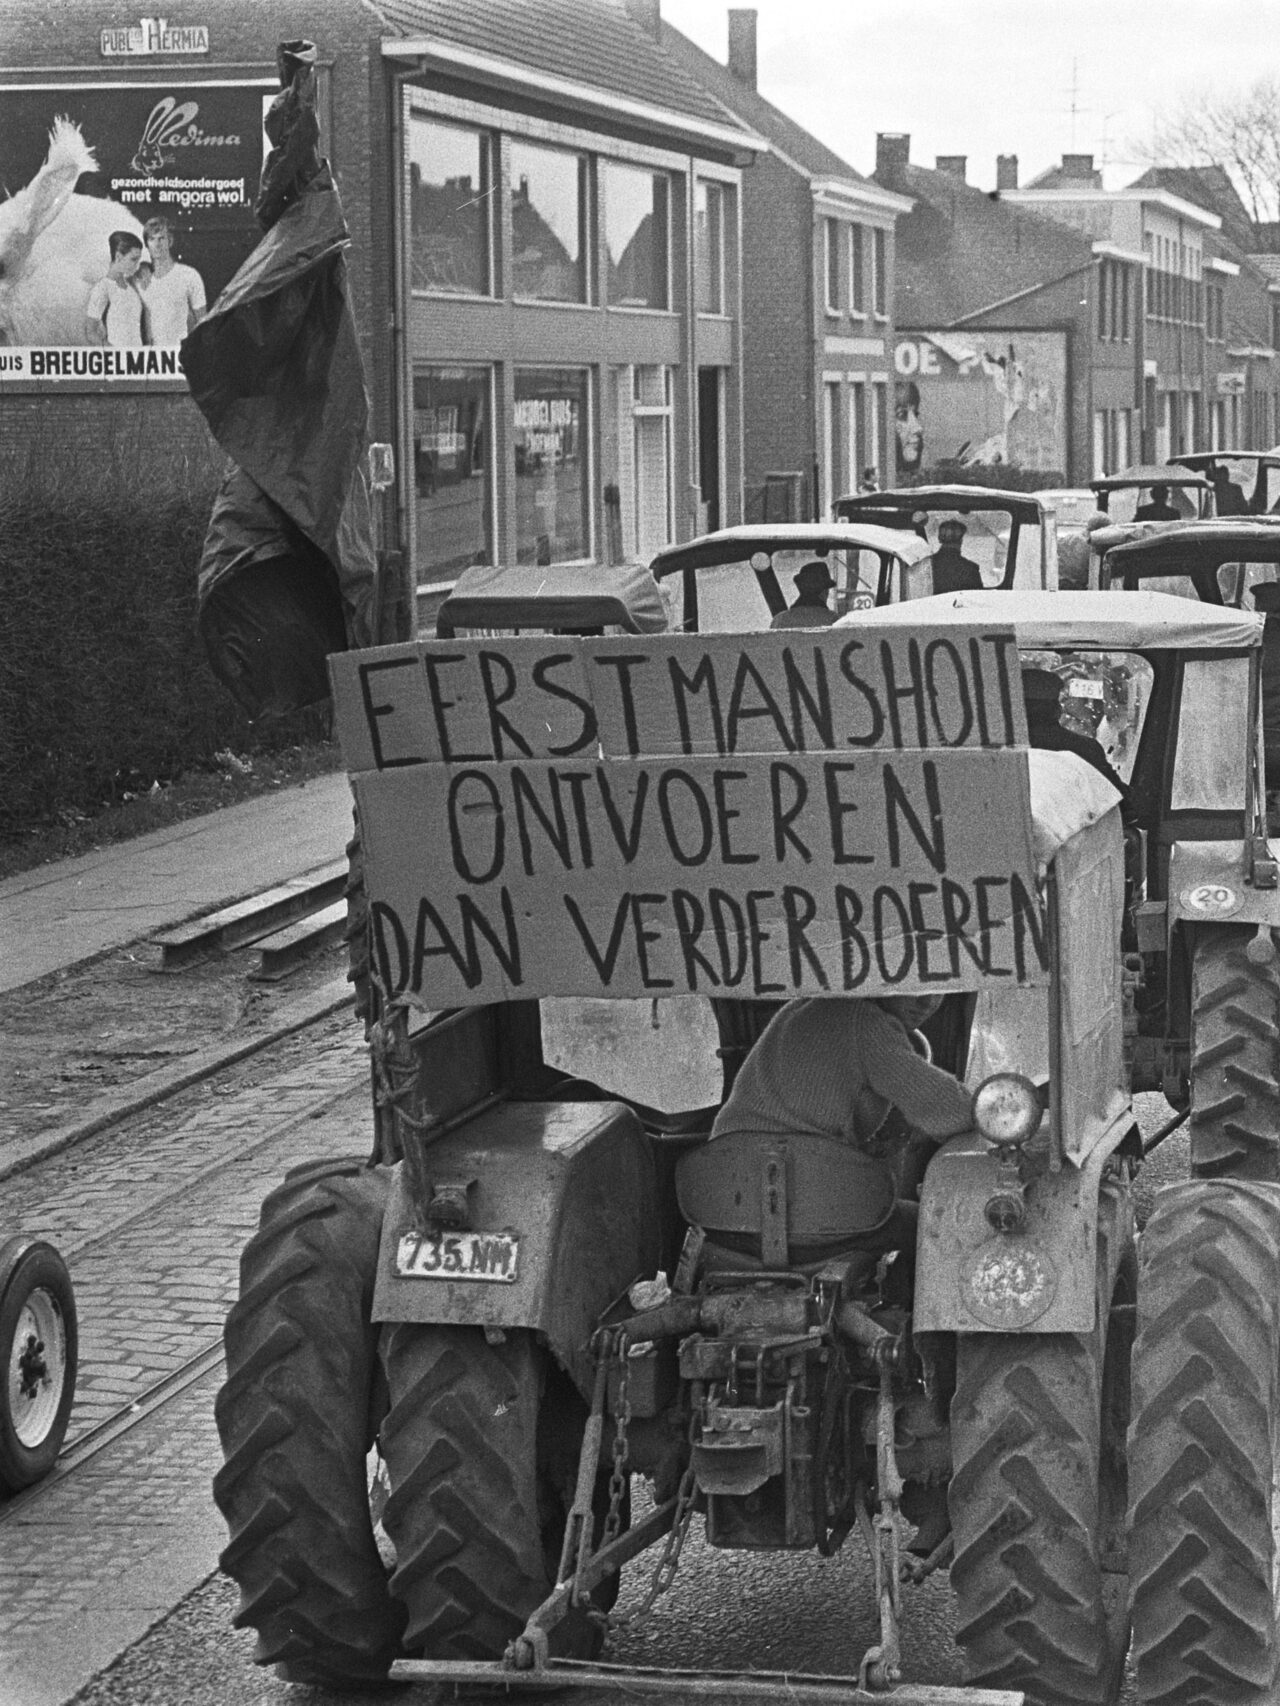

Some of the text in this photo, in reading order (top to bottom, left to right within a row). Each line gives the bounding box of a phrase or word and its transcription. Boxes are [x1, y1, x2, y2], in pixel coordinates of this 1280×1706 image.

[148, 22, 206, 50] HERMIA
[140, 96, 241, 146] Medima
[121, 189, 151, 202] met
[217, 187, 244, 203] wol
[30, 350, 184, 375] BREUGELMAN
[358, 651, 651, 771] EERST
[447, 758, 946, 885] ONTVOEREN
[1199, 889, 1228, 902] 20
[370, 872, 1050, 996] DAN VERDER BOEREN
